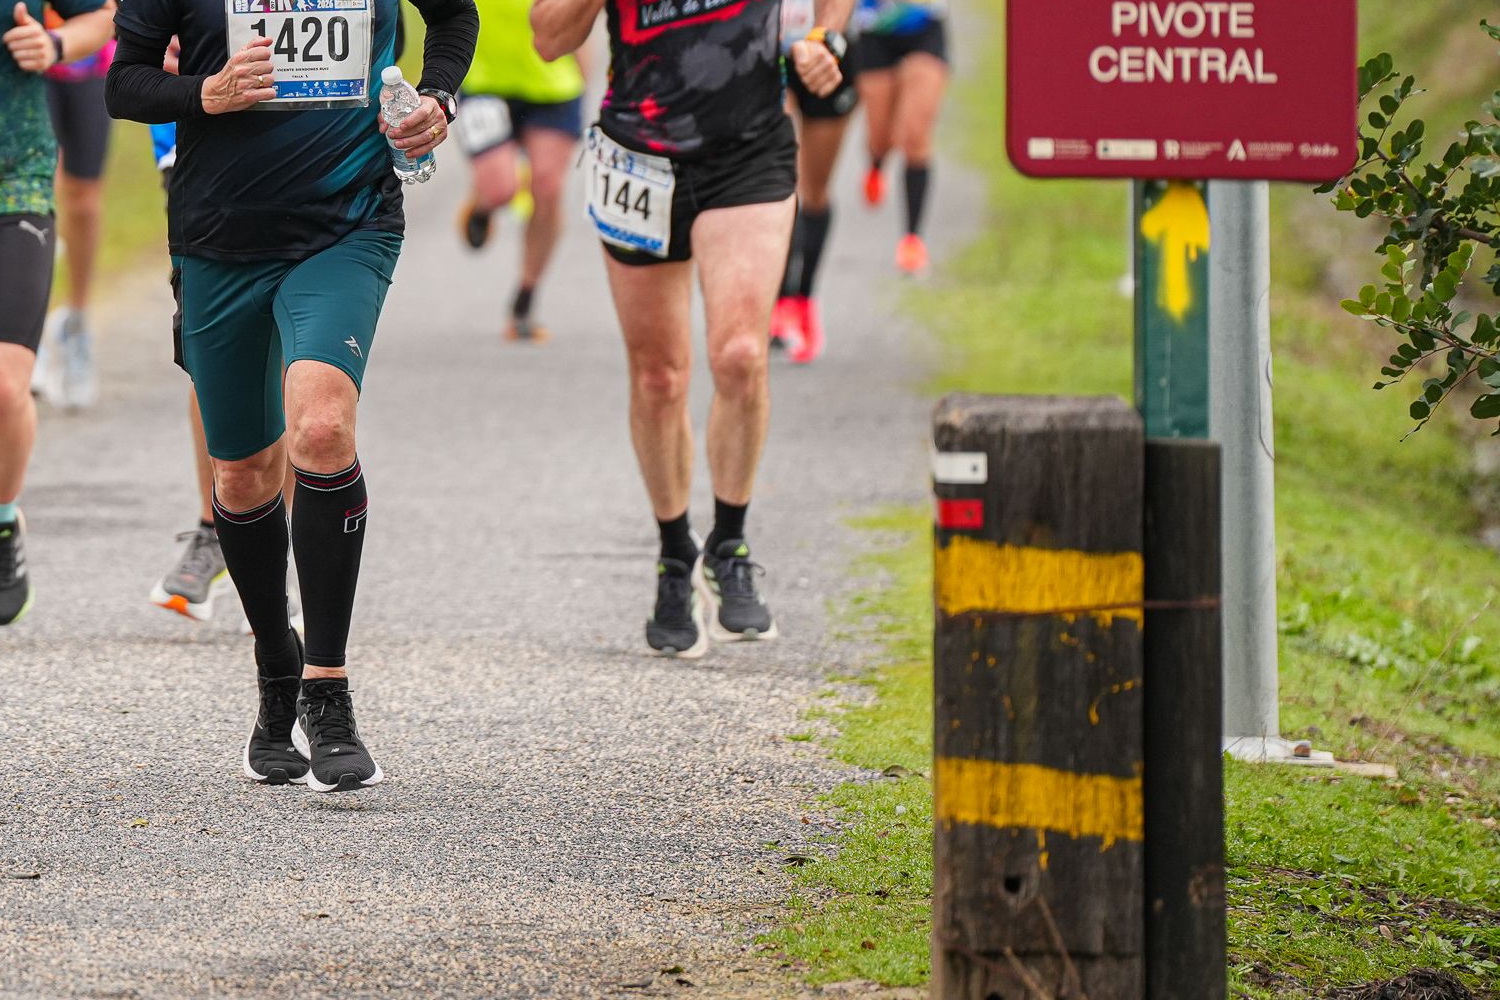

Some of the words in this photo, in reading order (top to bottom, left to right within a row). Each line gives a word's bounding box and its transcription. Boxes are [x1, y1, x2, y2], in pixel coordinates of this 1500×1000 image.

[250, 15, 349, 63] 1420
[1111, 1, 1255, 38] PIVOTE
[1088, 45, 1278, 84] CENTRAL
[601, 173, 652, 220] 144
